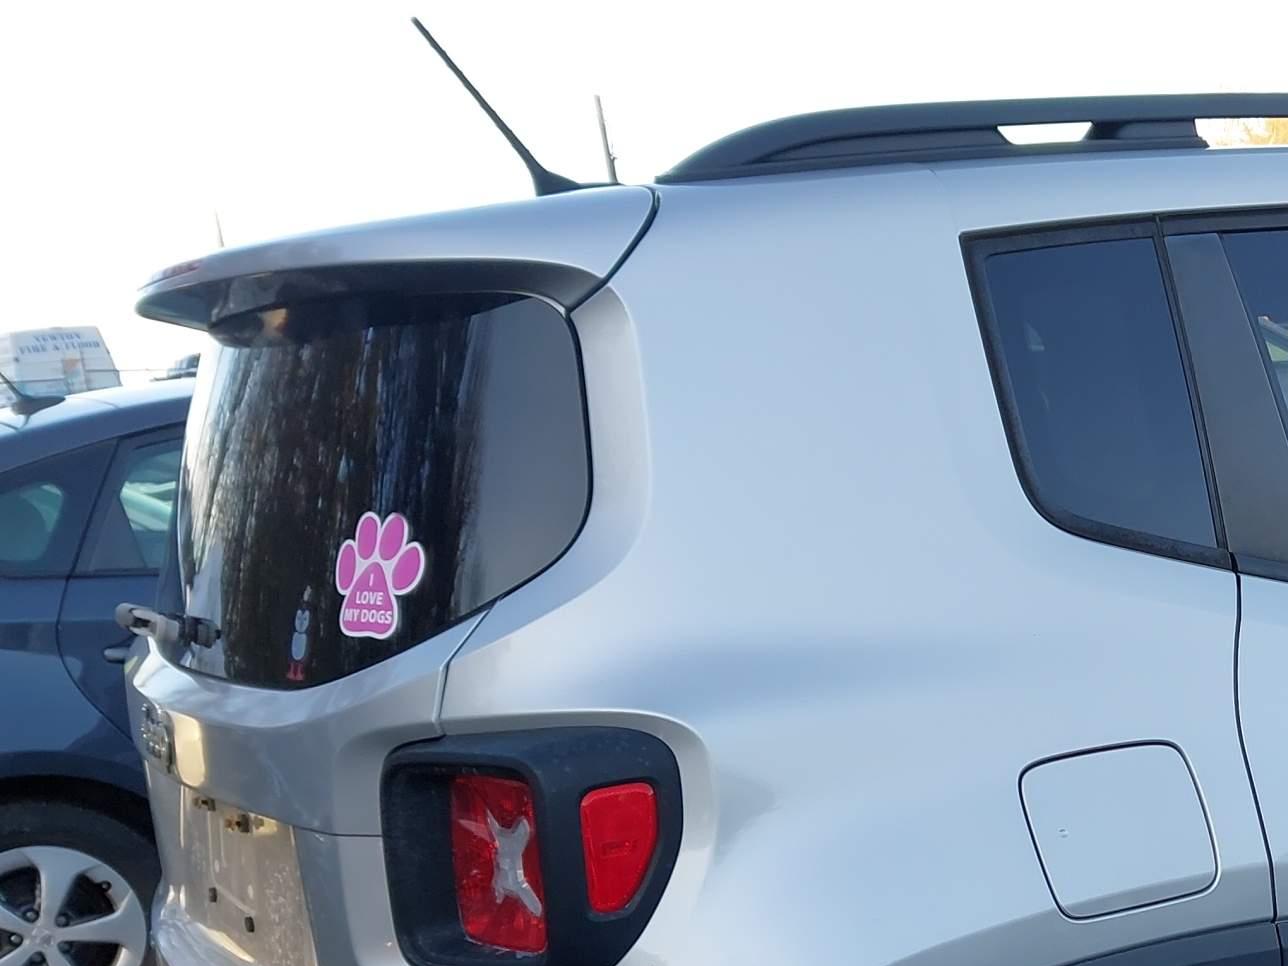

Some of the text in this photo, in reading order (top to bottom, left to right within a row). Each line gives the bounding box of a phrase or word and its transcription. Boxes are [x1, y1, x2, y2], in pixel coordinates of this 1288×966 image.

[368, 573, 374, 587] I
[355, 591, 384, 606] LOVE
[343, 608, 393, 624] MY DOGS
